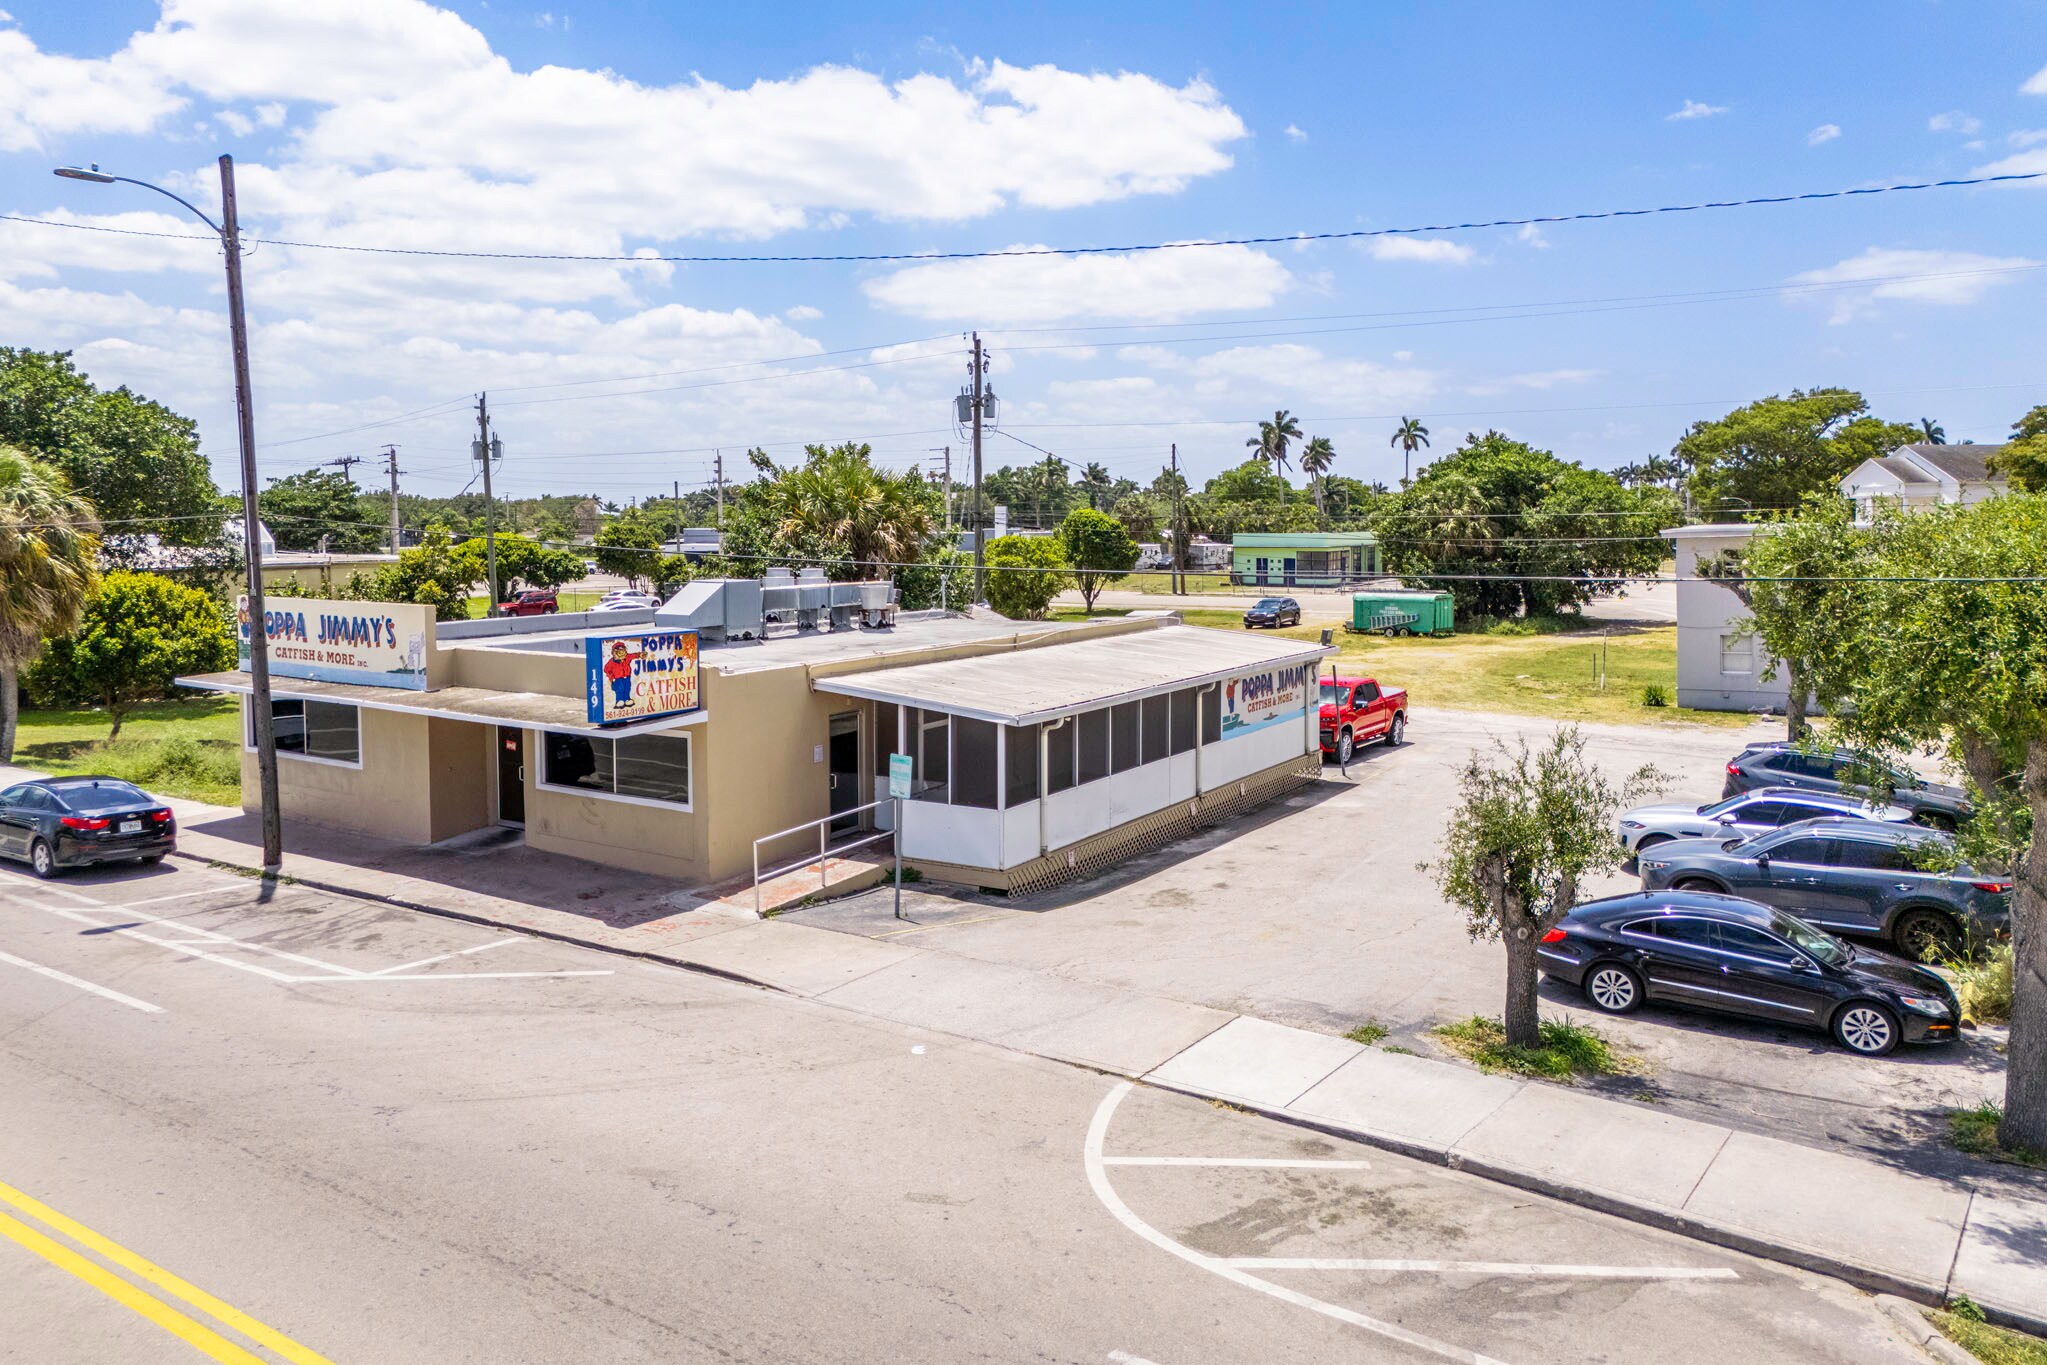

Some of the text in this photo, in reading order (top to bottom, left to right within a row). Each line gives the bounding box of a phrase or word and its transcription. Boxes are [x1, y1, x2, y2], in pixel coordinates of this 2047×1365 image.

[265, 611, 396, 649] OPPA JIMMY'S
[641, 635, 683, 652] POPPA
[275, 647, 315, 661] CATFISH
[317, 650, 324, 661] &
[326, 651, 355, 666] MORE
[591, 669, 599, 707] 149
[635, 676, 697, 697] CATFISH
[1242, 673, 1273, 702] POPPA
[646, 691, 693, 713] & MORE
[1247, 698, 1271, 712] CATFISH
[1272, 696, 1276, 706] &
[1277, 692, 1293, 705] MORE
